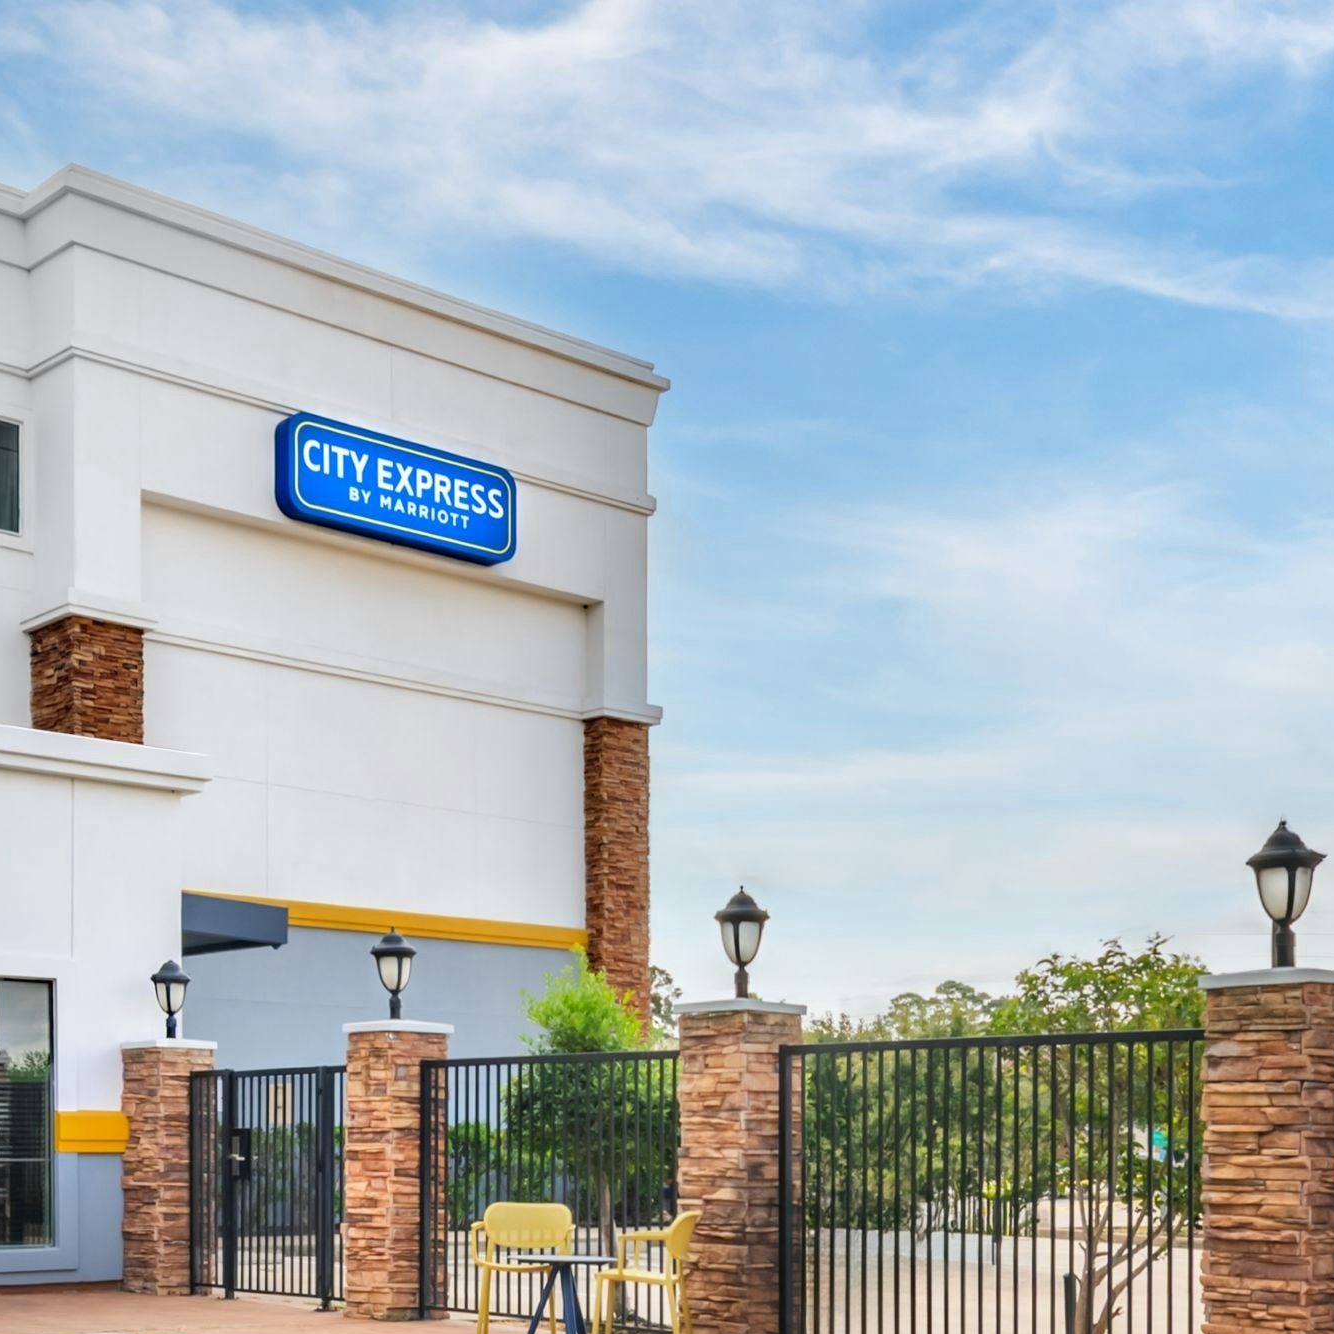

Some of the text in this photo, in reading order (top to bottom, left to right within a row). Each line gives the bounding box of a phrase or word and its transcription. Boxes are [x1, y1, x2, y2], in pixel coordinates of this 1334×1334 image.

[303, 439, 504, 519] CITY EXPRESS
[349, 486, 469, 529] BY MARRIOTT
